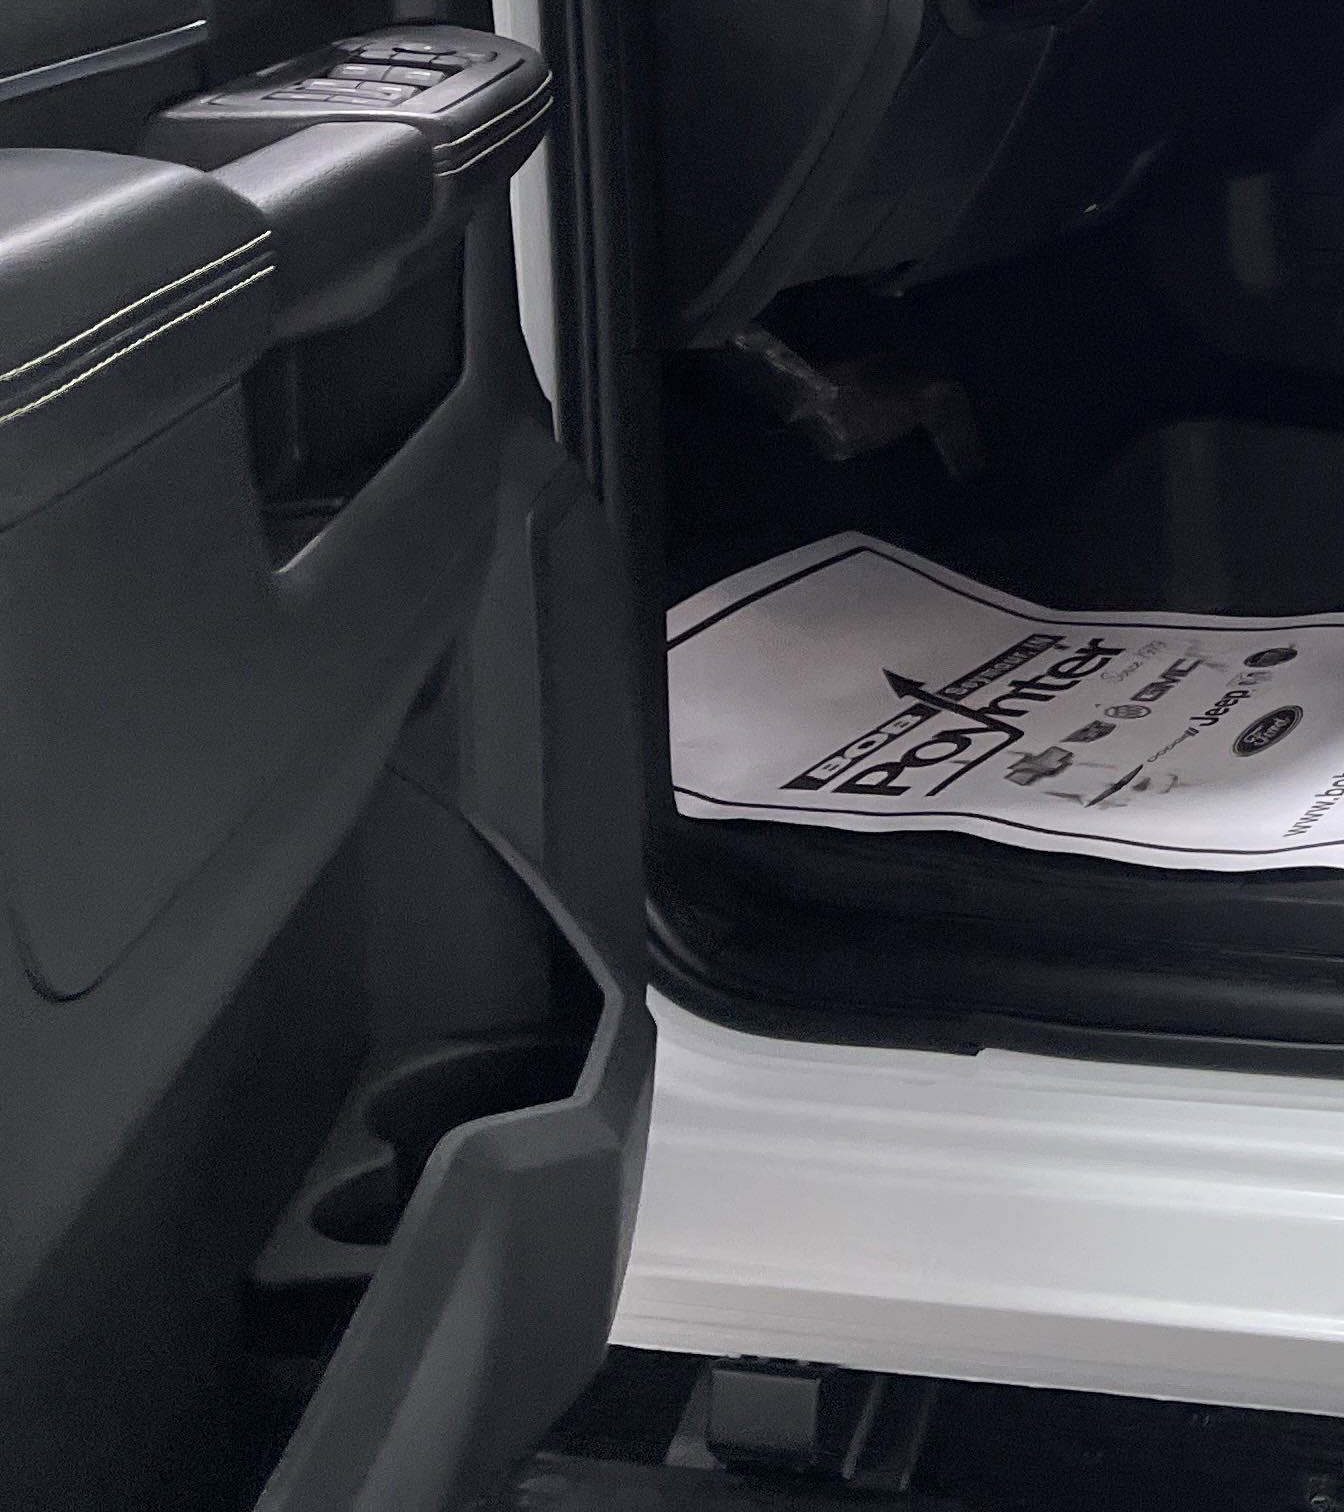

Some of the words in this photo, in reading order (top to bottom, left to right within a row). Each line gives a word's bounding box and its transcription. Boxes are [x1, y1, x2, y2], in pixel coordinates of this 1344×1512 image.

[1131, 658, 1201, 702] GMC
[1189, 689, 1252, 727] Jeep
[831, 638, 1126, 797] Poynter
[804, 712, 923, 781] BOB
